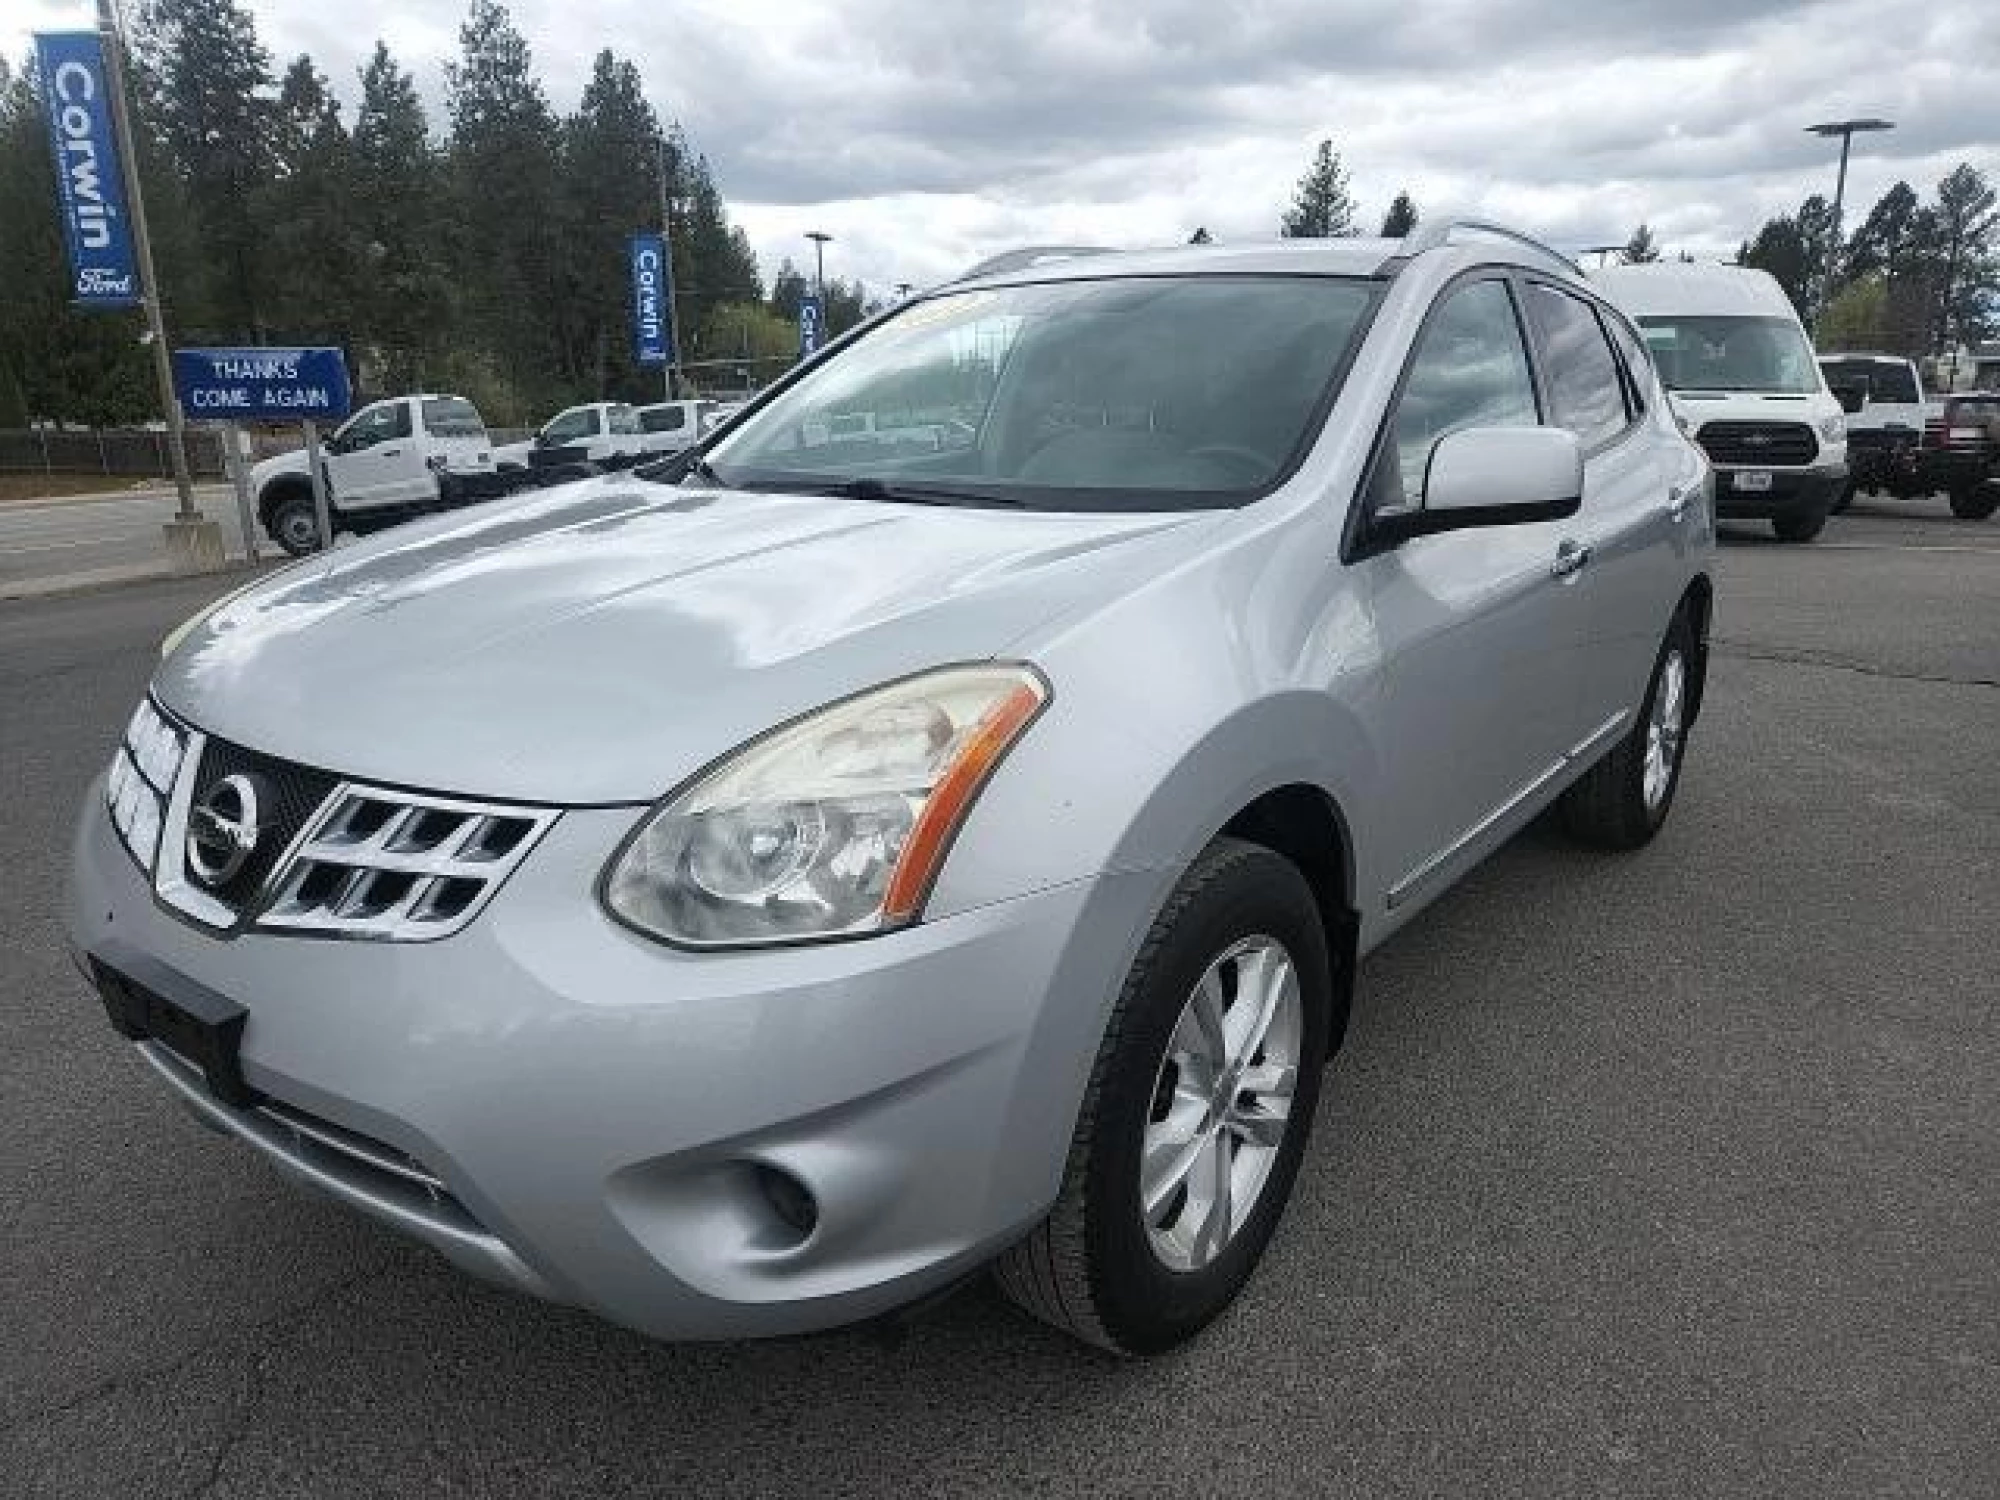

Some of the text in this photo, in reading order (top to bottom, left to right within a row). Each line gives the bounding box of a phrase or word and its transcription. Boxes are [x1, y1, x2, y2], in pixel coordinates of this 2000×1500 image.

[56, 62, 117, 248] Corwin
[640, 249, 662, 338] Corwin
[213, 360, 298, 379] THANKS
[193, 388, 329, 407] COME AGAIN
